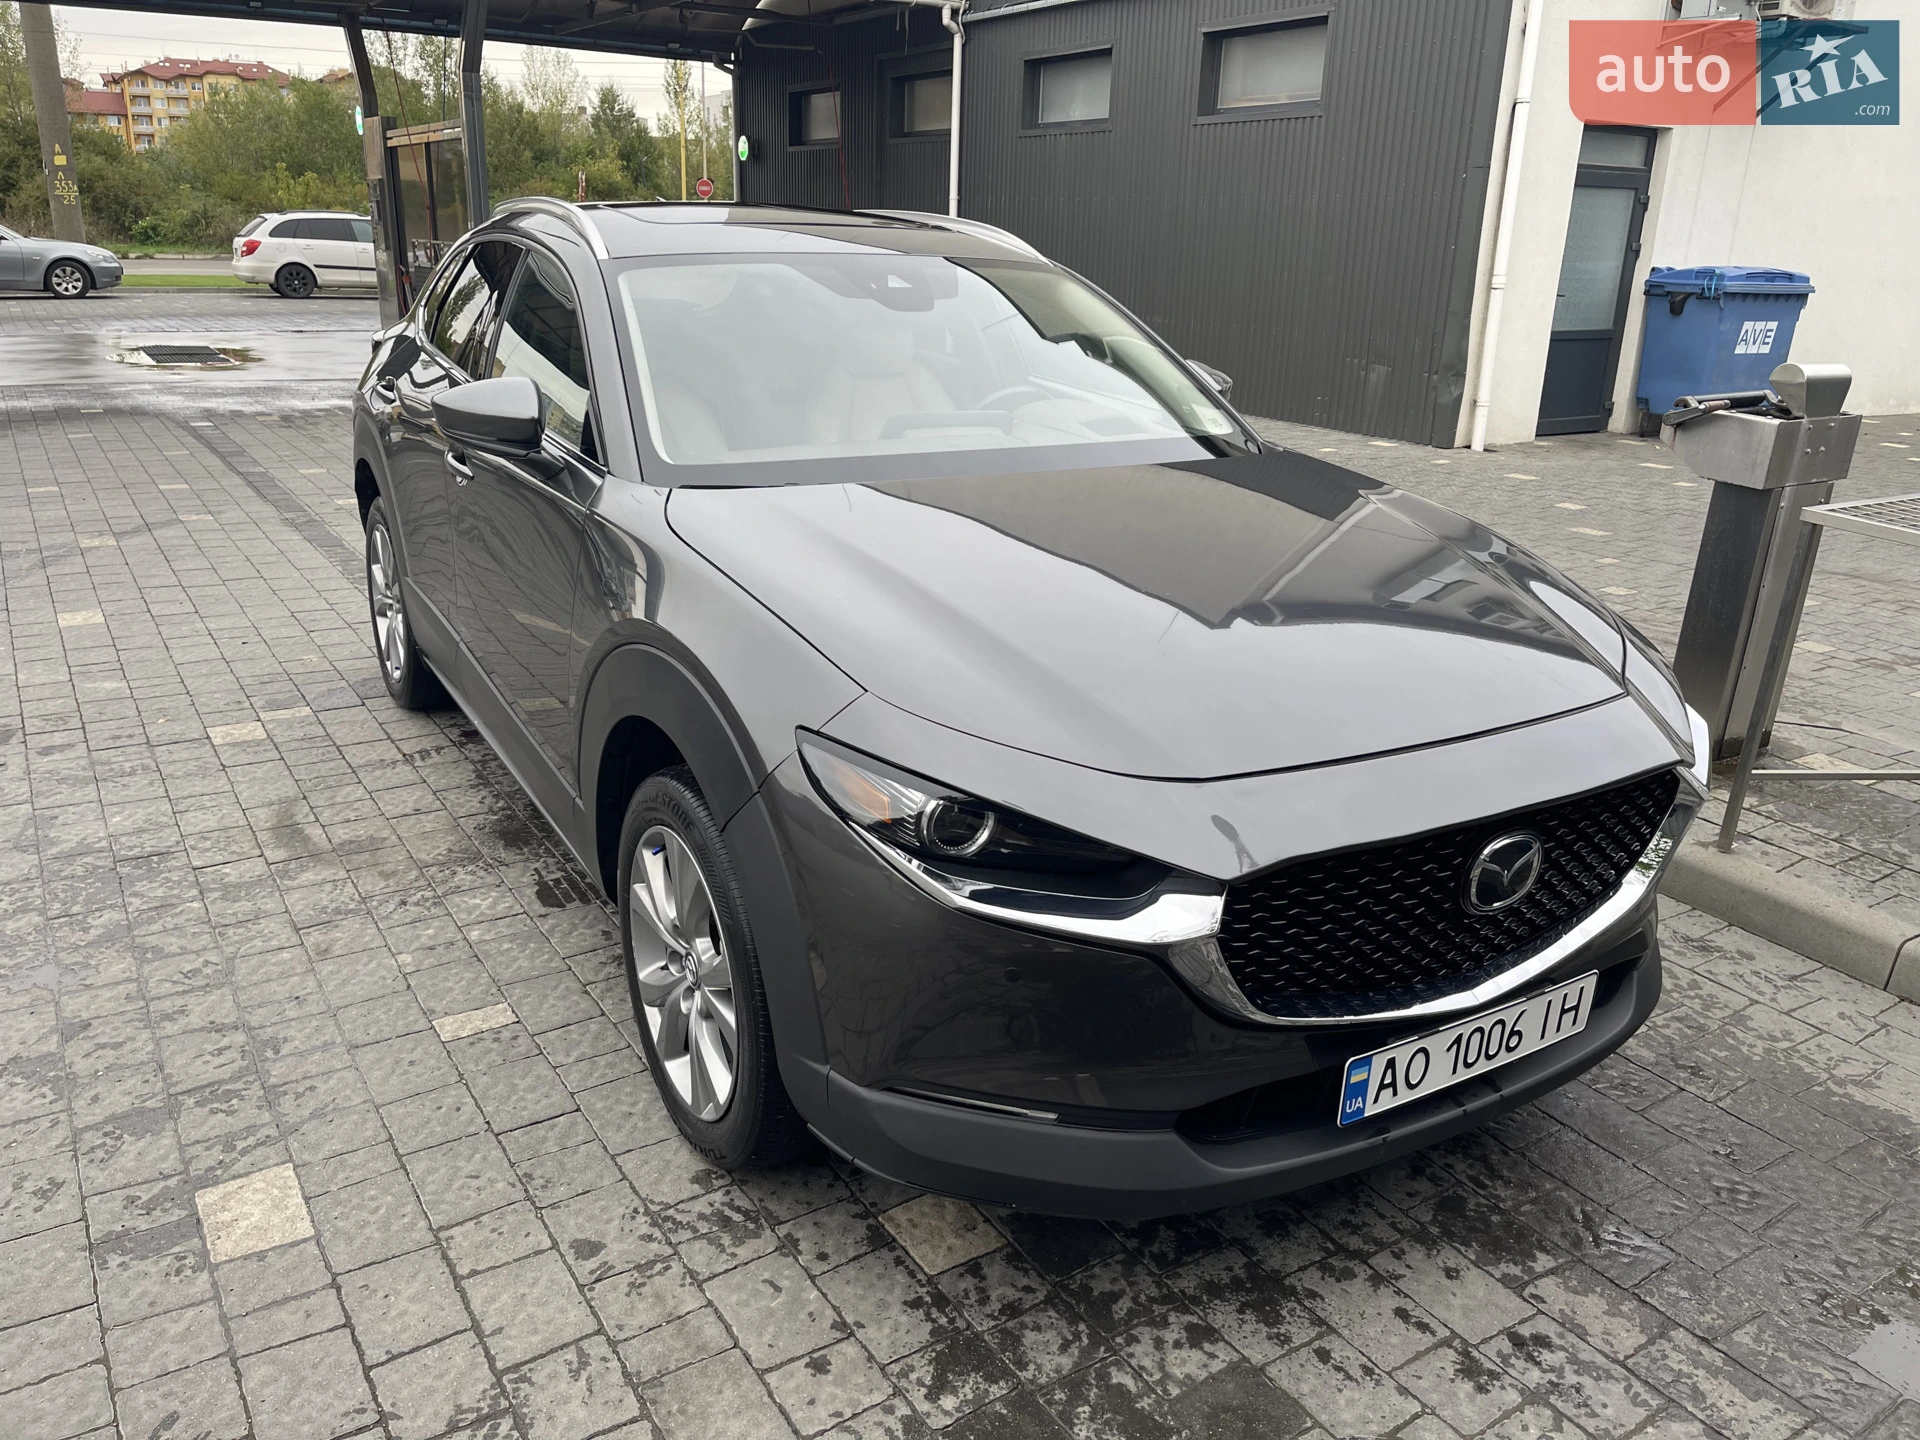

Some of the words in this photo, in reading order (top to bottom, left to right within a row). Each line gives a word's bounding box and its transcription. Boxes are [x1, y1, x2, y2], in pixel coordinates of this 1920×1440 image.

[63, 195, 77, 205] 25
[1737, 328, 1775, 346] AVE
[1371, 1046, 1430, 1104] AO
[1446, 1007, 1528, 1076] 1006
[1540, 984, 1585, 1040] IH
[1345, 1096, 1364, 1113] UA
